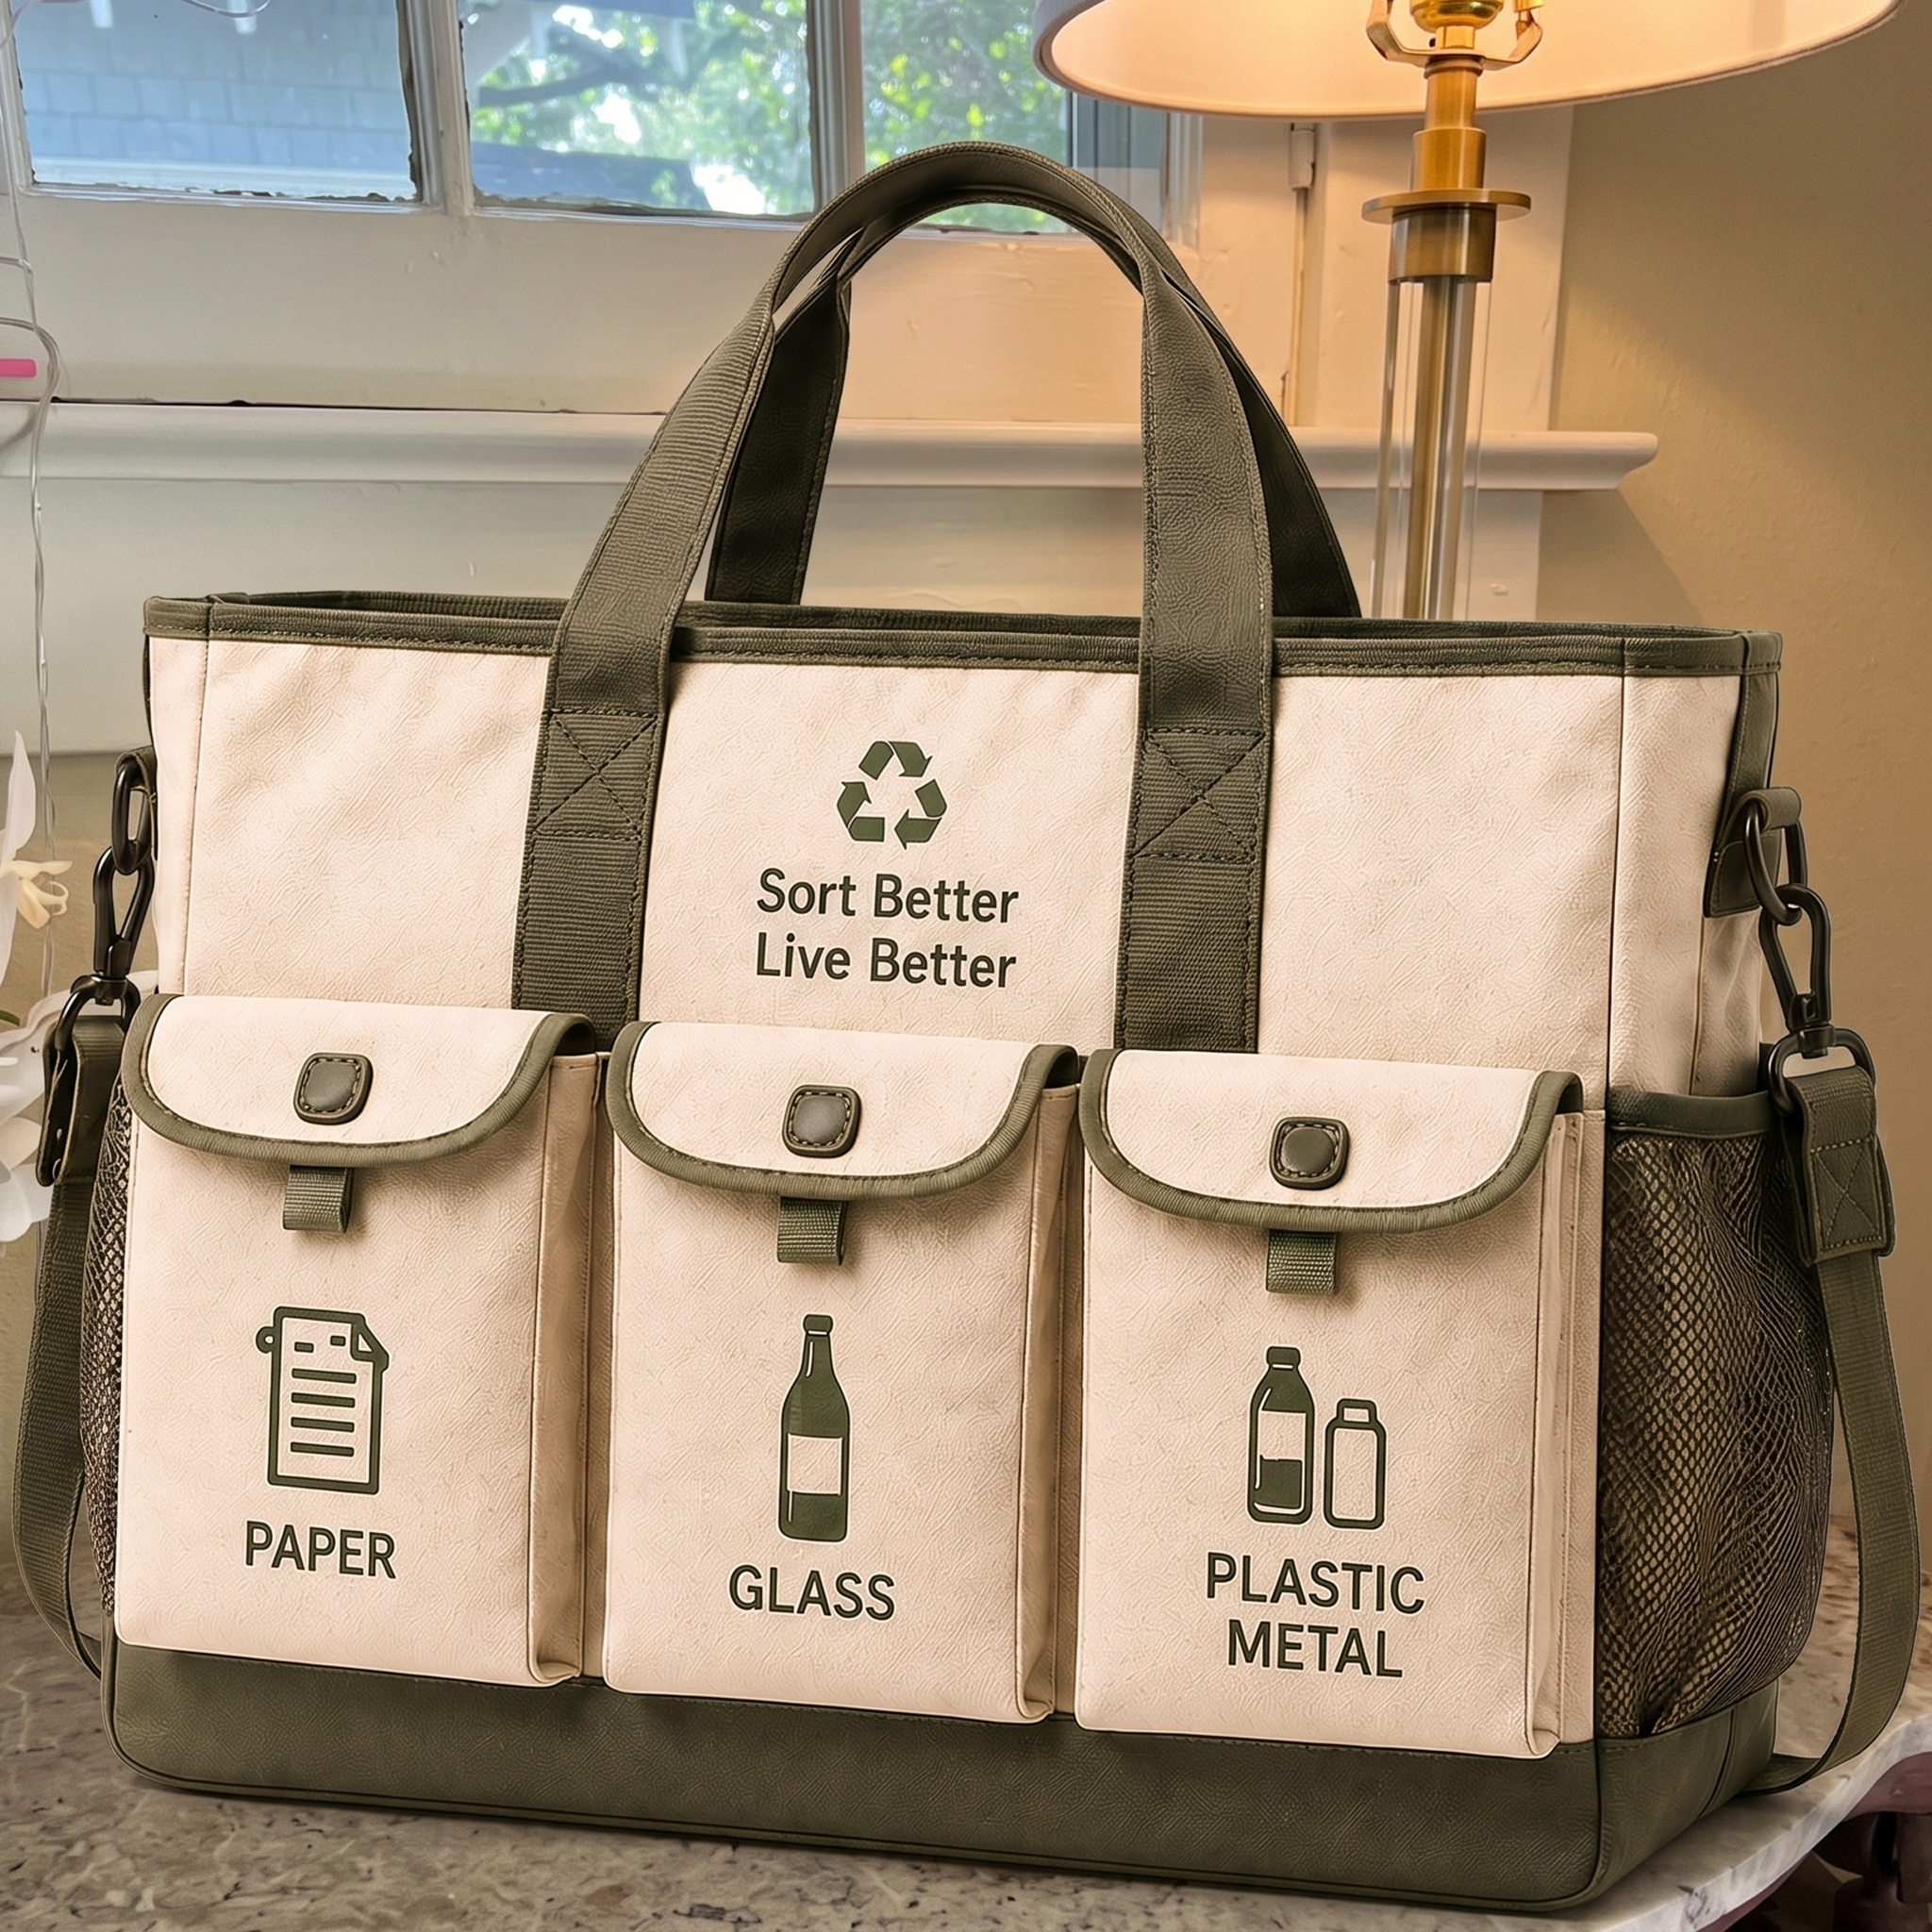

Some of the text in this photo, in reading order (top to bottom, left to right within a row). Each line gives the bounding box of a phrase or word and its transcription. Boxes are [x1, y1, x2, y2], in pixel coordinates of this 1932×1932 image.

[757, 867, 1020, 924] Sort Better
[756, 931, 1017, 989] Live Better
[245, 1520, 396, 1579] PAPER
[728, 1564, 895, 1622] GLASS
[1207, 1552, 1425, 1615] PLASTIC
[1227, 1618, 1403, 1678] METAL
